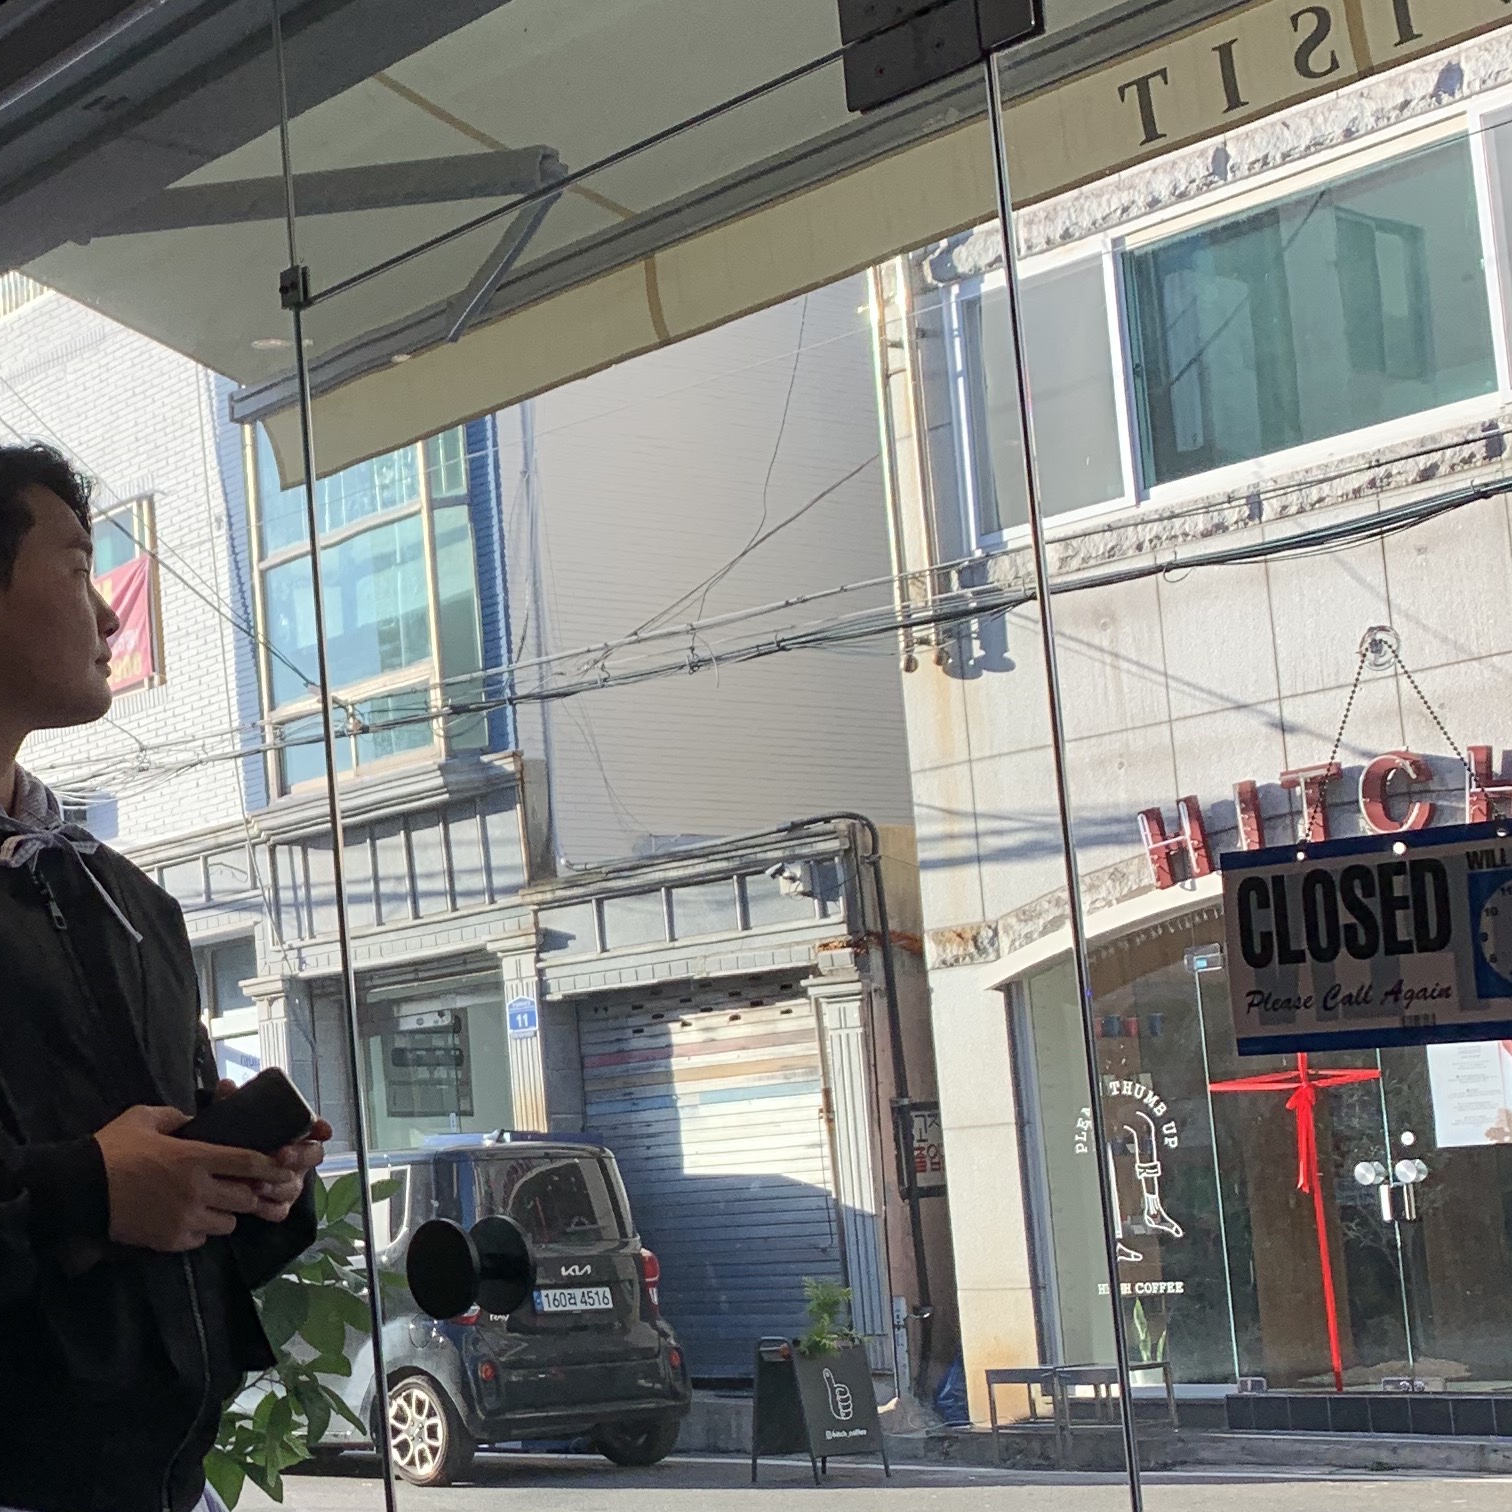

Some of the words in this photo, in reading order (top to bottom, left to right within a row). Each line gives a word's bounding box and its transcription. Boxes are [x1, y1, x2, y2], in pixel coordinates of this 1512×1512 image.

[1238, 858, 1453, 968] CLOSED
[1245, 989, 1314, 1015] Please
[1322, 983, 1373, 1012] Call
[1380, 979, 1453, 1010] Again
[516, 1013, 528, 1028] 11
[1109, 1081, 1167, 1117] THUMB
[1162, 1121, 1178, 1148] UP
[580, 1290, 610, 1307] 4516
[1134, 1281, 1184, 1294] COFFEE
